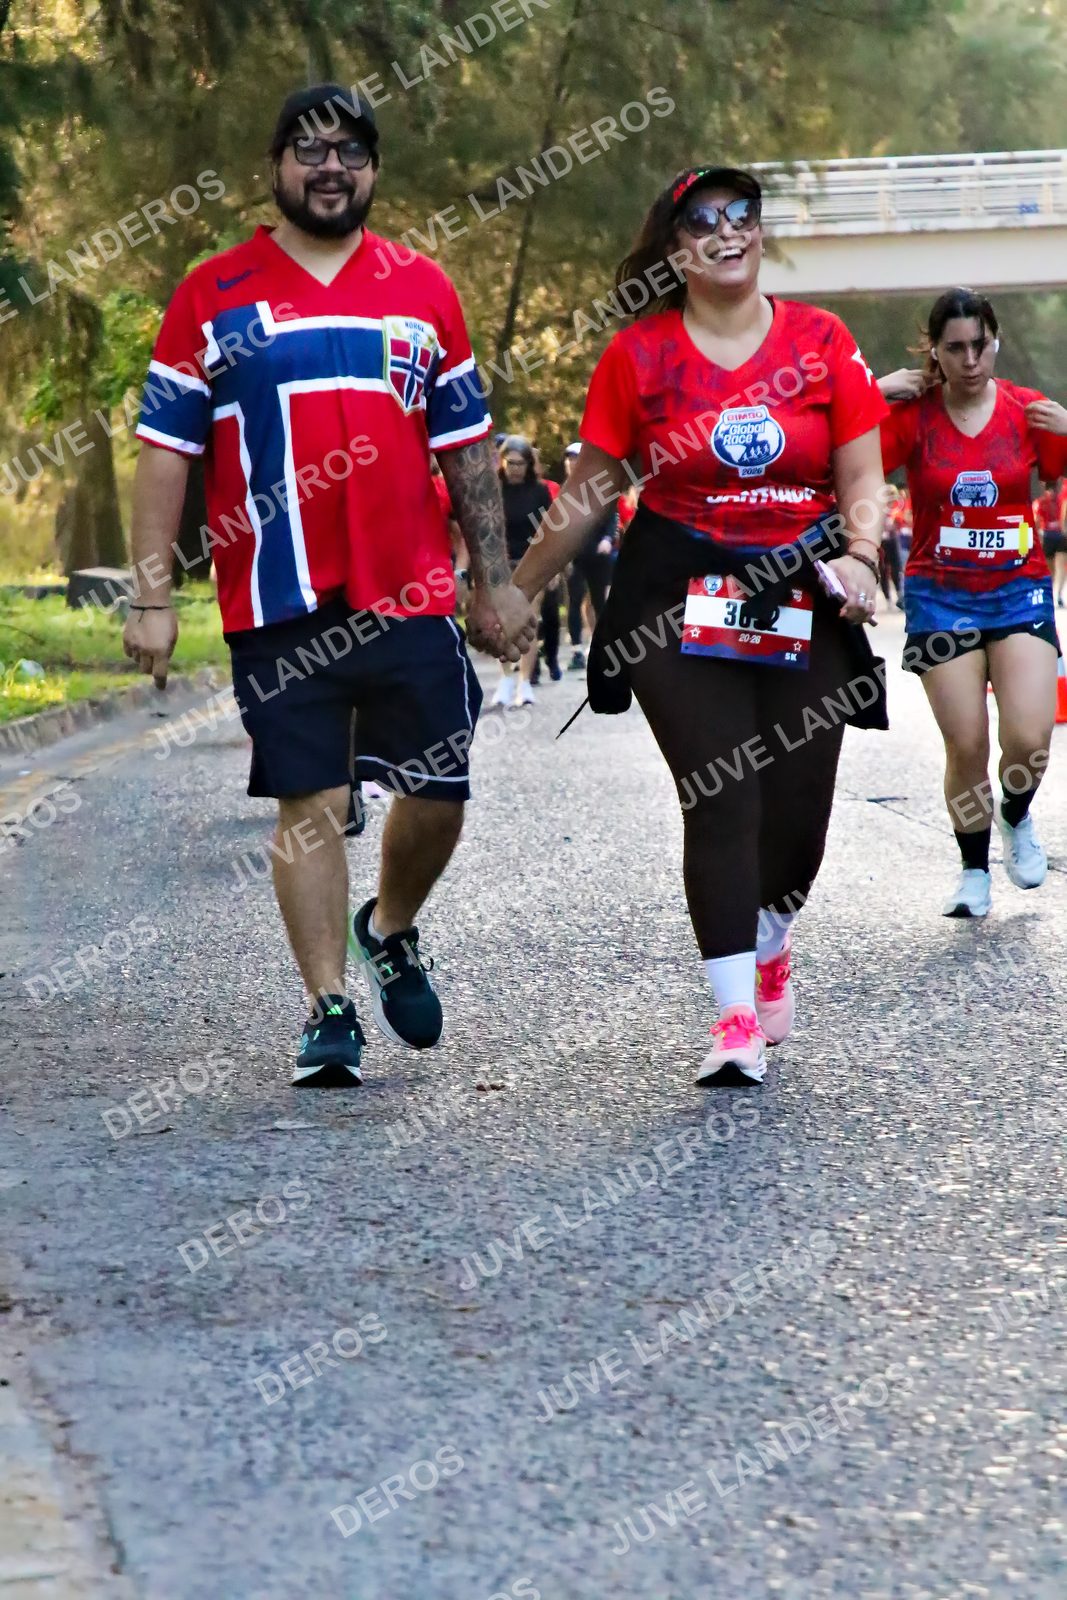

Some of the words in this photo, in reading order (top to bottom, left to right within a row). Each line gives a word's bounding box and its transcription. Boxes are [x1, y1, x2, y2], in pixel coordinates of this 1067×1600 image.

[727, 412, 763, 422] BIMBO
[729, 422, 765, 435] Global
[723, 433, 753, 445] Race
[741, 466, 763, 476] 2026
[968, 530, 1005, 549] 3125
[784, 652, 797, 661] 5K
